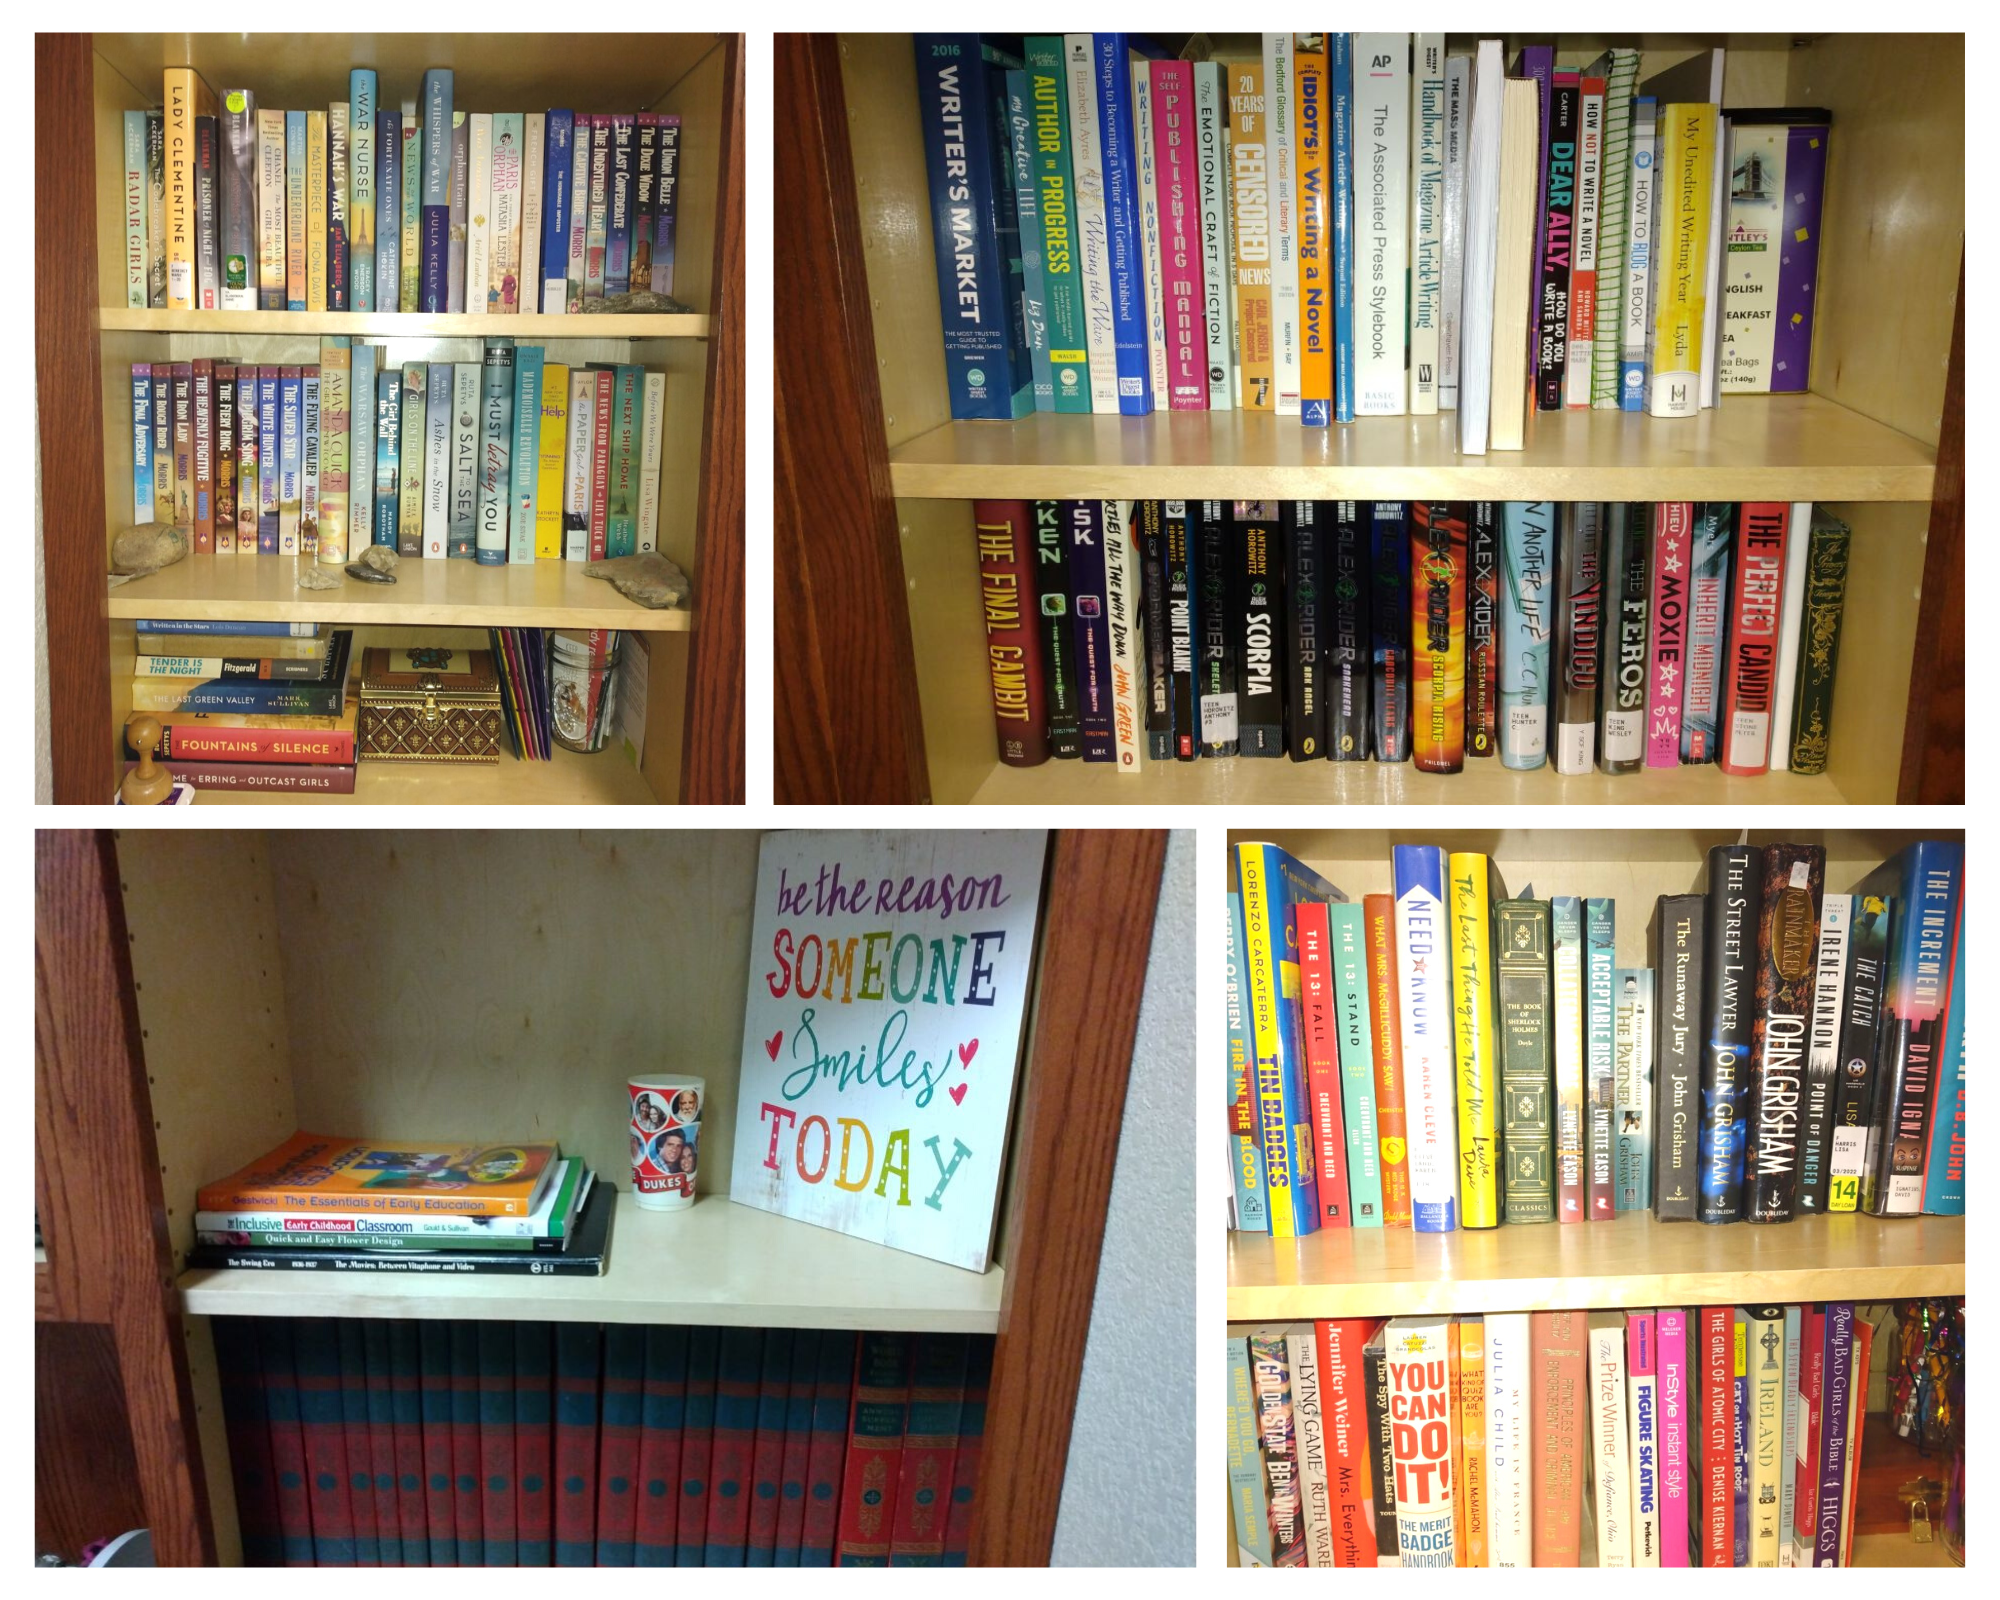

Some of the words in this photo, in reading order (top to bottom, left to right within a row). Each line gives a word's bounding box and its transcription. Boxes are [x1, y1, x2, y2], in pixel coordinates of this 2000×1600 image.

[931, 45, 961, 57] 2016
[1371, 55, 1392, 69] AP
[359, 79, 367, 90] the
[1239, 75, 1254, 93] 20
[172, 86, 183, 130] LADY
[358, 92, 369, 132] WAR
[1033, 75, 1061, 153] AUTHOR
[1230, 94, 1264, 114] YEARS
[1241, 114, 1256, 133] OF
[1372, 104, 1388, 138] The
[1587, 103, 1599, 128] HOW
[332, 108, 345, 183] HANNAH'S
[432, 97, 442, 157] WHISPERS
[938, 65, 970, 202] WRITER'S
[1586, 131, 1598, 156] NOT
[1686, 117, 1700, 141] My
[357, 138, 368, 198] NURSE
[431, 168, 439, 193] WAR
[1046, 159, 1056, 170] IN
[1551, 142, 1575, 208] DEAR
[1584, 159, 1596, 172] TO
[1682, 144, 1700, 212] Unedited
[128, 171, 141, 228] RADAR
[173, 137, 184, 243] CLEMENTINE
[332, 188, 345, 222] WAR
[1233, 143, 1269, 262] CENSORED
[1369, 143, 1388, 233] Associated
[1583, 177, 1596, 212] WRITE
[1636, 180, 1649, 216] HOW
[1042, 176, 1071, 275] PROGRESS
[1580, 228, 1592, 262] NOVEL
[1634, 219, 1648, 241] TO
[1677, 215, 1696, 274] Writing
[129, 231, 142, 285] GIRLS
[430, 254, 438, 290] KELLY
[951, 207, 981, 324] MARKET
[1371, 237, 1387, 282] Press
[1631, 242, 1648, 270] BLOG
[1239, 268, 1271, 285] NEWS
[1632, 274, 1644, 283] A
[1677, 276, 1689, 304] Year
[1369, 284, 1387, 360] Stylebook
[1630, 288, 1643, 327] BOOK
[1736, 358, 1759, 367] Bags
[488, 396, 502, 441] MUST
[540, 404, 565, 419] Help
[458, 434, 473, 476] SALT
[481, 443, 507, 494] betray
[465, 476, 471, 486] TO
[457, 490, 472, 522] SEA
[484, 498, 498, 532] YOU
[978, 521, 1015, 563] THE
[1247, 529, 1257, 574] HOROWITZ
[1256, 529, 1267, 575] ANTHONY
[982, 572, 1021, 634] FINAL
[1658, 575, 1683, 663] MOXIE
[150, 658, 189, 667] TENDER
[150, 666, 167, 674] THE
[169, 667, 202, 675] NIGHT
[224, 663, 256, 673] Fitzgerald
[1246, 612, 1272, 696] SCORPIA
[990, 645, 1029, 723] GAMBIT
[1432, 656, 1445, 701] SCORPIA
[154, 695, 169, 703] THE
[195, 696, 224, 704] GREEN
[1432, 705, 1444, 743] RISING
[182, 740, 258, 752] FOUNTAINS
[273, 744, 329, 754] SILENCE
[198, 775, 237, 784] ERRING
[248, 777, 296, 786] OUTCAST
[300, 778, 330, 787] GIRLS
[777, 868, 814, 916] be
[815, 863, 872, 917] the
[1728, 854, 1748, 892] THE
[1245, 861, 1261, 933] LORENZO
[1253, 938, 1267, 1033] CARCATERRA
[1306, 929, 1318, 962] THE
[1677, 918, 1691, 947] The
[1725, 894, 1747, 961] STREET
[766, 928, 1006, 1007] SOMEONE
[1821, 929, 1842, 977] IRENE
[1309, 972, 1321, 997] 13:
[1674, 950, 1691, 1019] Runaway
[1721, 964, 1744, 1032] LAWYER
[1314, 1004, 1324, 1043] FALL
[1814, 983, 1836, 1050] HANNON
[781, 1008, 953, 1108] Smiles
[1673, 1020, 1689, 1057] Jury
[1766, 1009, 1805, 1079] JOHN
[1259, 1054, 1279, 1094] TIN
[1712, 1044, 1738, 1101] JOHN
[1672, 1074, 1688, 1111] John
[1263, 1098, 1289, 1189] BADGES
[1671, 1113, 1689, 1169] Grisham
[1713, 1102, 1733, 1188] GRISHAM
[1757, 1080, 1799, 1175] GRISHAM
[760, 1101, 973, 1211] TODAY
[643, 1176, 681, 1189] DUKES
[1833, 1180, 1856, 1199] 14
[284, 1194, 306, 1207] The
[310, 1195, 370, 1208] Essentials
[374, 1197, 386, 1210] of
[390, 1198, 420, 1212] Early
[425, 1199, 486, 1211] Education
[1509, 1204, 1548, 1212] CLASSICS
[235, 1217, 282, 1231] Inclusive
[265, 1234, 293, 1246] Quick
[296, 1235, 312, 1244] and
[314, 1236, 334, 1248] Easy
[337, 1236, 367, 1245] Flower
[370, 1236, 404, 1247] Design
[287, 1220, 308, 1232] Early
[310, 1220, 352, 1230] Childhood
[357, 1219, 413, 1233] Classroom
[424, 1224, 439, 1232] Gould
[448, 1224, 469, 1232] Sullivan
[1389, 1360, 1445, 1393] YOU
[1663, 1364, 1678, 1418] InStyle
[1392, 1391, 1446, 1421] CAN
[1637, 1385, 1652, 1442] FIGURE
[1392, 1421, 1448, 1461] DO
[1667, 1422, 1682, 1467] instant
[1396, 1459, 1449, 1506] IT!
[1639, 1446, 1654, 1514] SKATING
[1665, 1469, 1682, 1499] style
